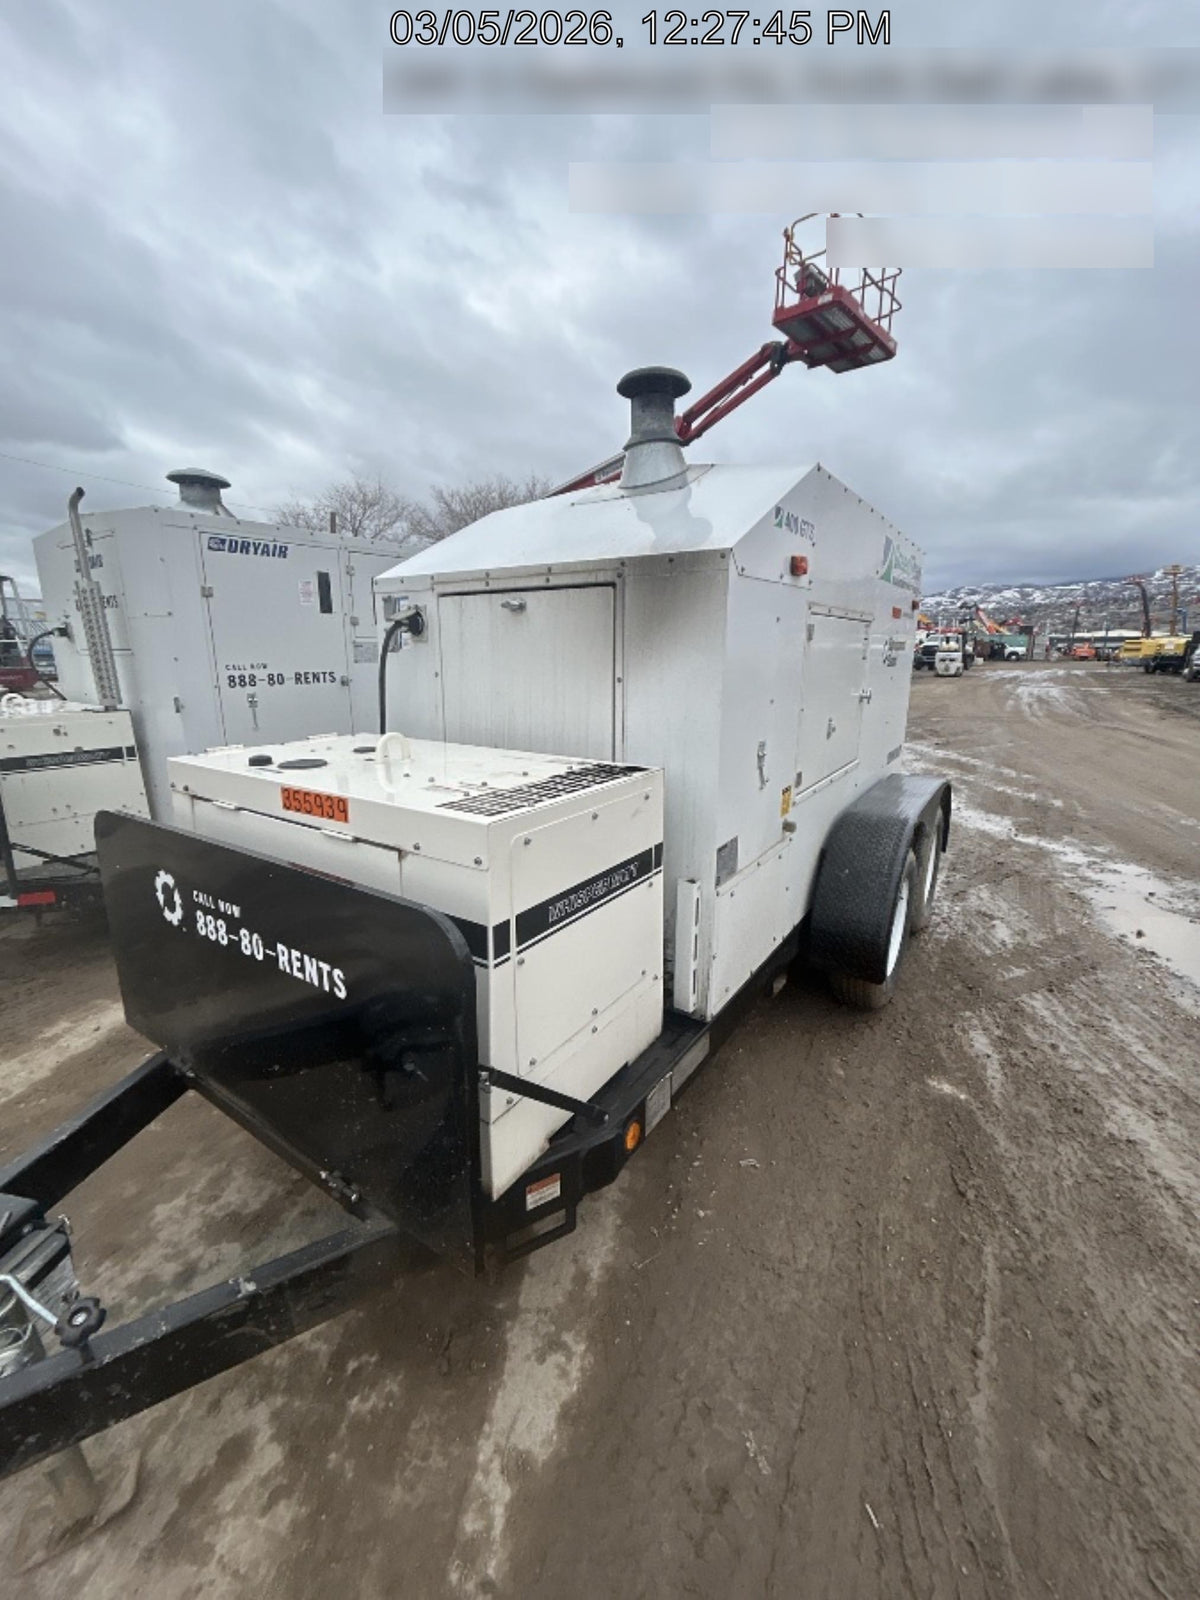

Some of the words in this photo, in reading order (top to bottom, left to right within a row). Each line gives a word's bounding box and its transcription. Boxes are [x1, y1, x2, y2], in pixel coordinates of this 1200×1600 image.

[227, 538, 289, 559] DRYAIR
[227, 671, 337, 688] 888-80-RENTS
[282, 787, 348, 823] 355939
[193, 890, 215, 909] CALL
[218, 899, 241, 918] NOW
[196, 910, 347, 999] 888-80-RENTS
